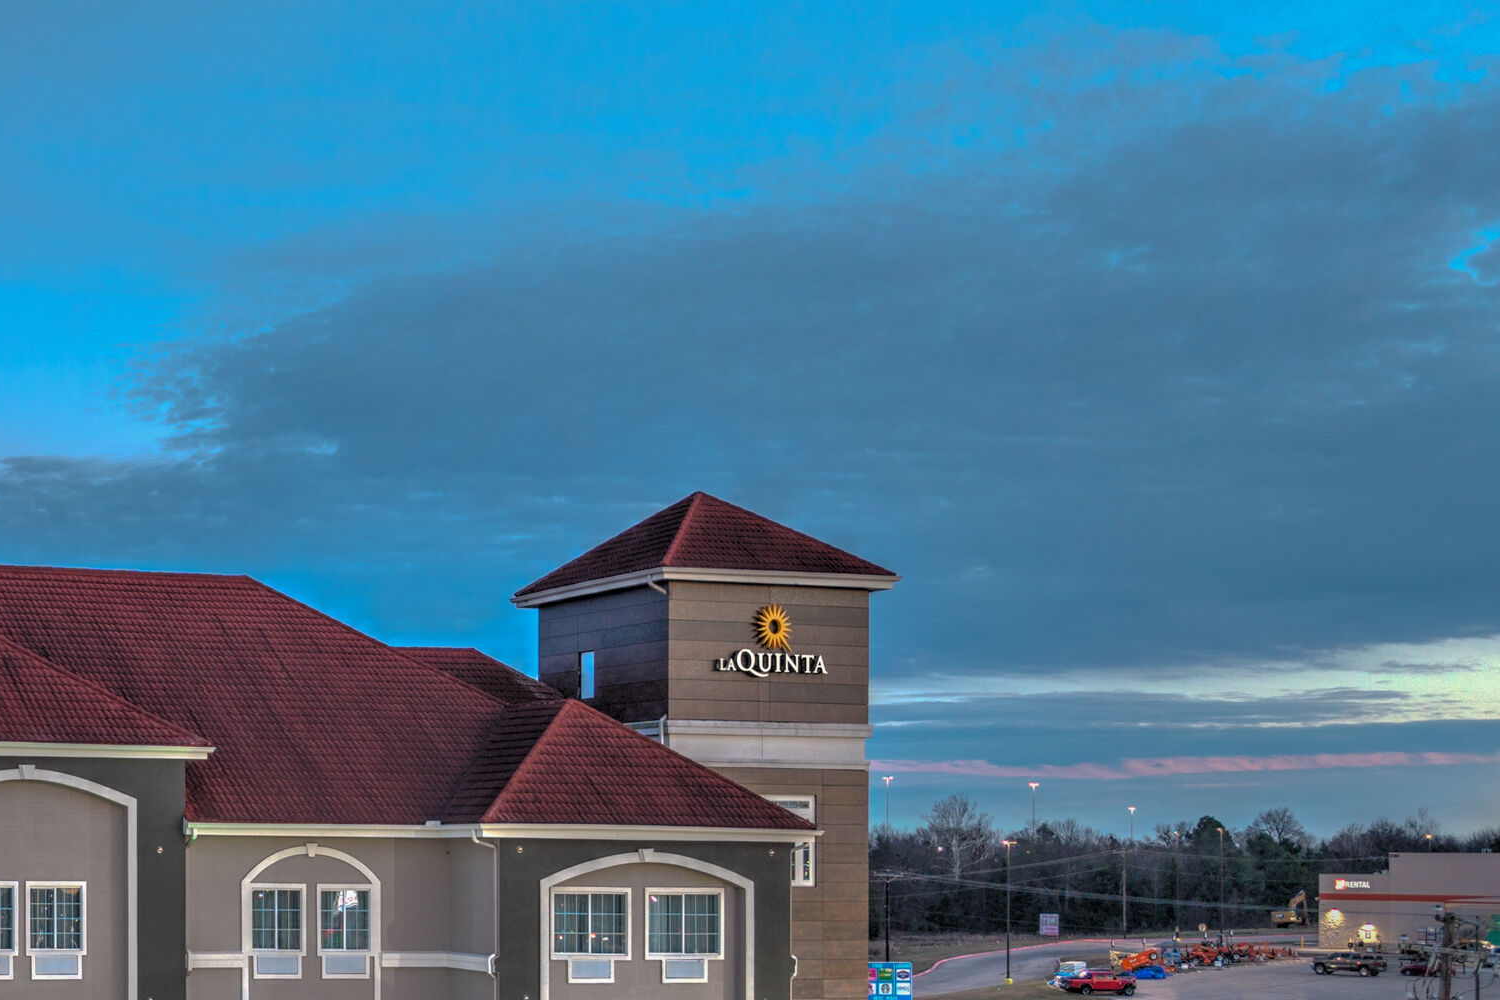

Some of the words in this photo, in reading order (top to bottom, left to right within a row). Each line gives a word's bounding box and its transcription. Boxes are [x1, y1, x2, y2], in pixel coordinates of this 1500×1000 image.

[719, 658, 737, 671] LA
[736, 648, 828, 677] QUINTA
[1345, 881, 1370, 889] RENTAL
